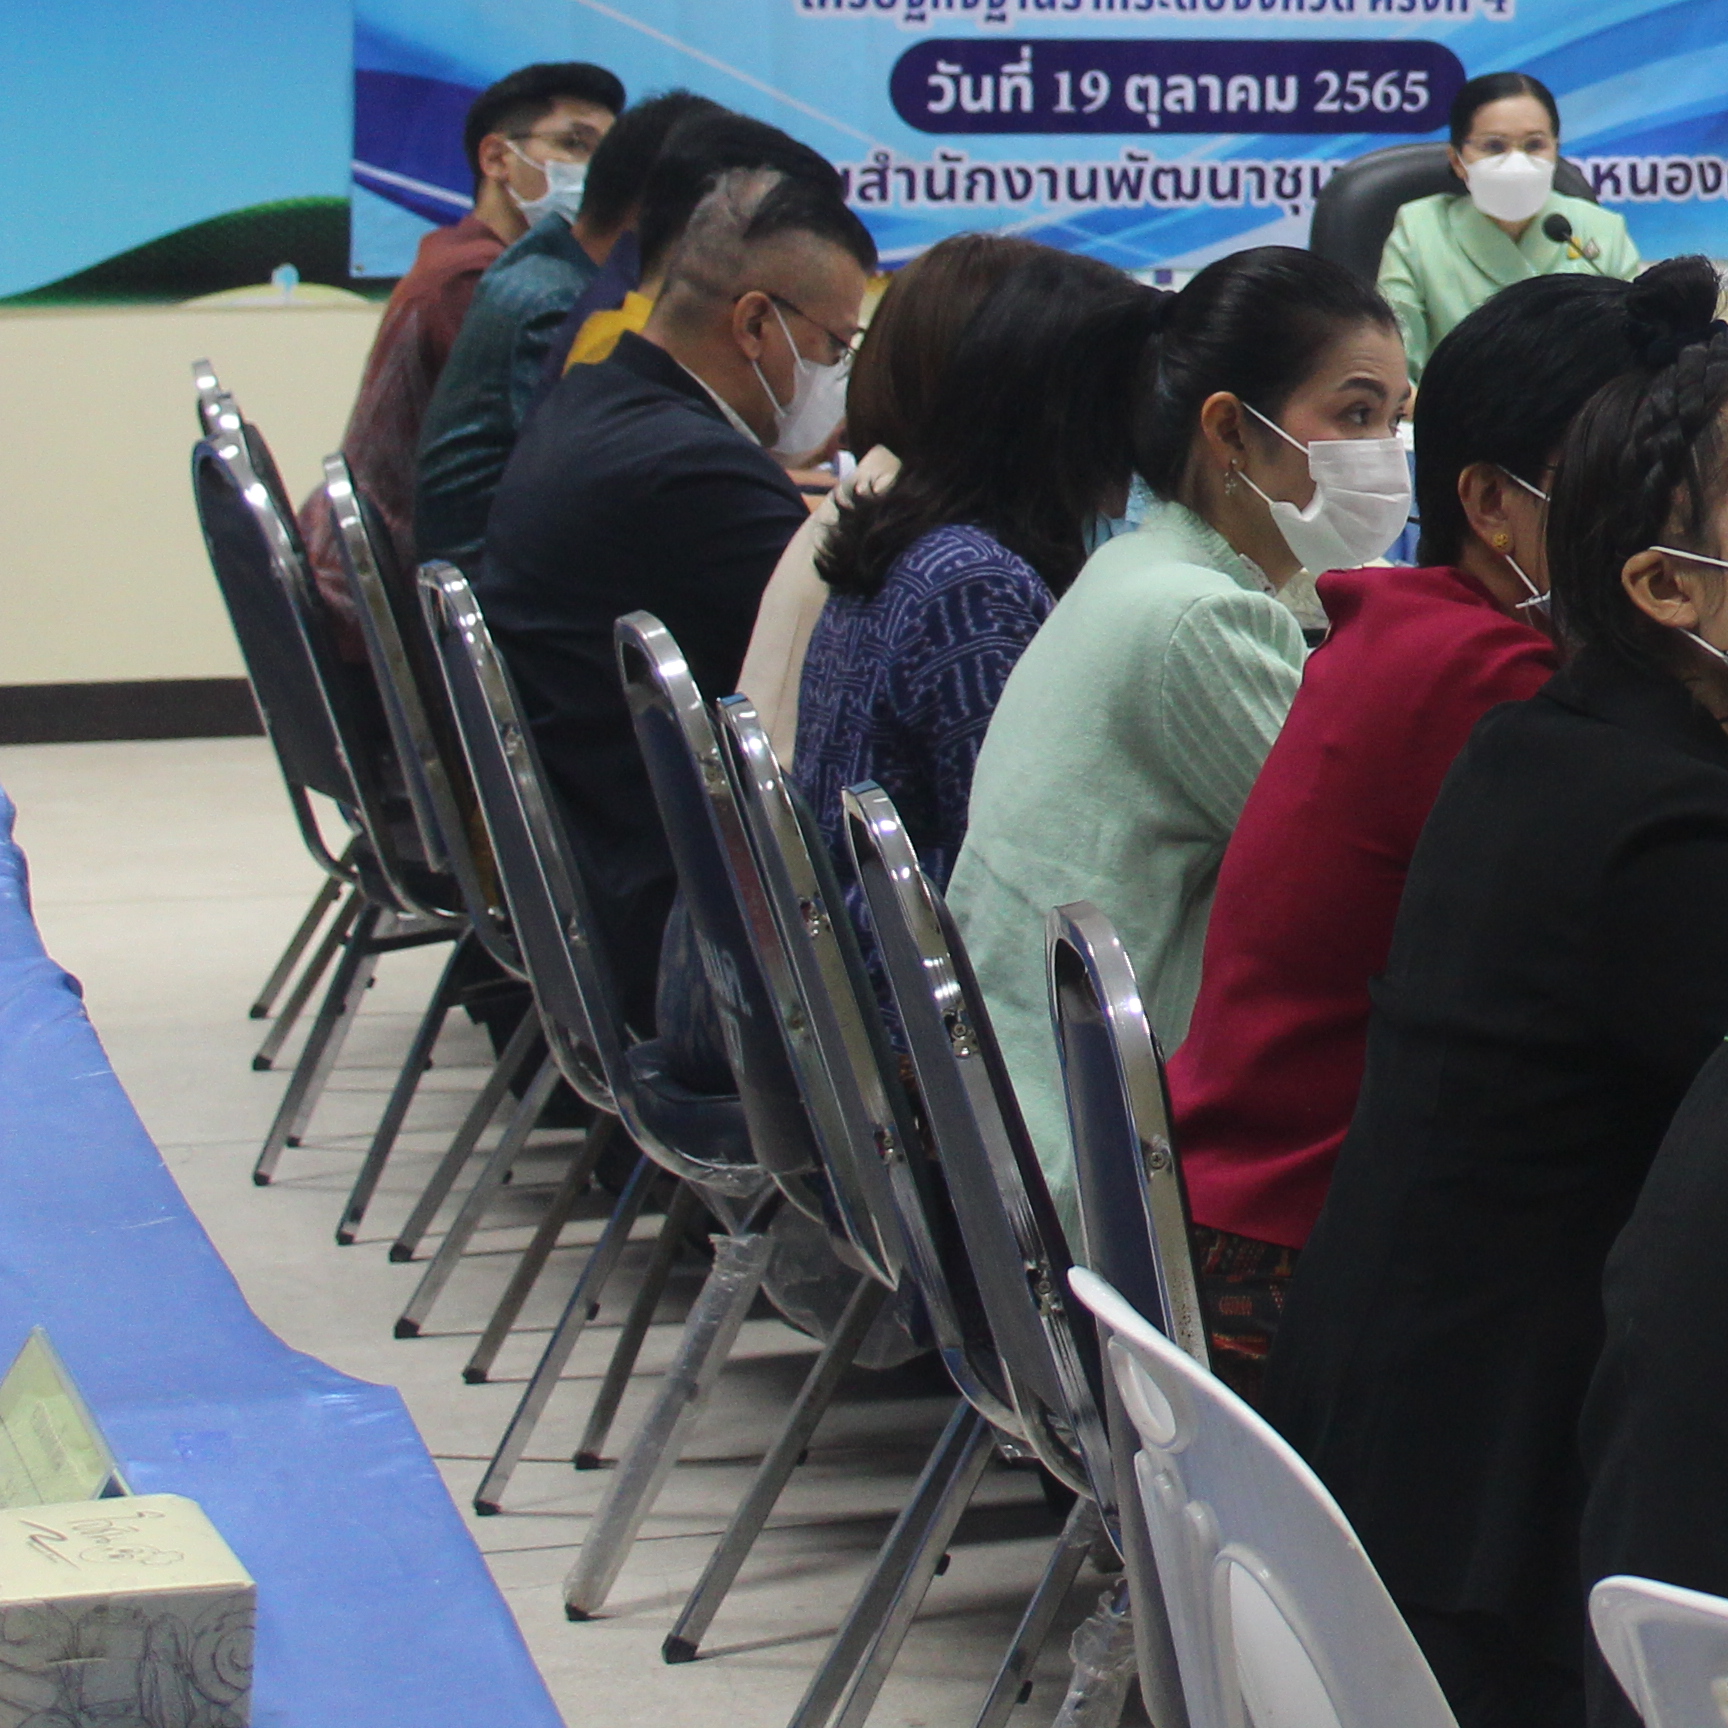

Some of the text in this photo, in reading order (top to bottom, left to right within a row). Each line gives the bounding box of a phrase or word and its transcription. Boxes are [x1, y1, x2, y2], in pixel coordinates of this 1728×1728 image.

[927, 46, 1430, 128] วันที่ 19 ตุลาคม 2565
[842, 151, 1338, 216] สำนักงานพัฒนาชุ
